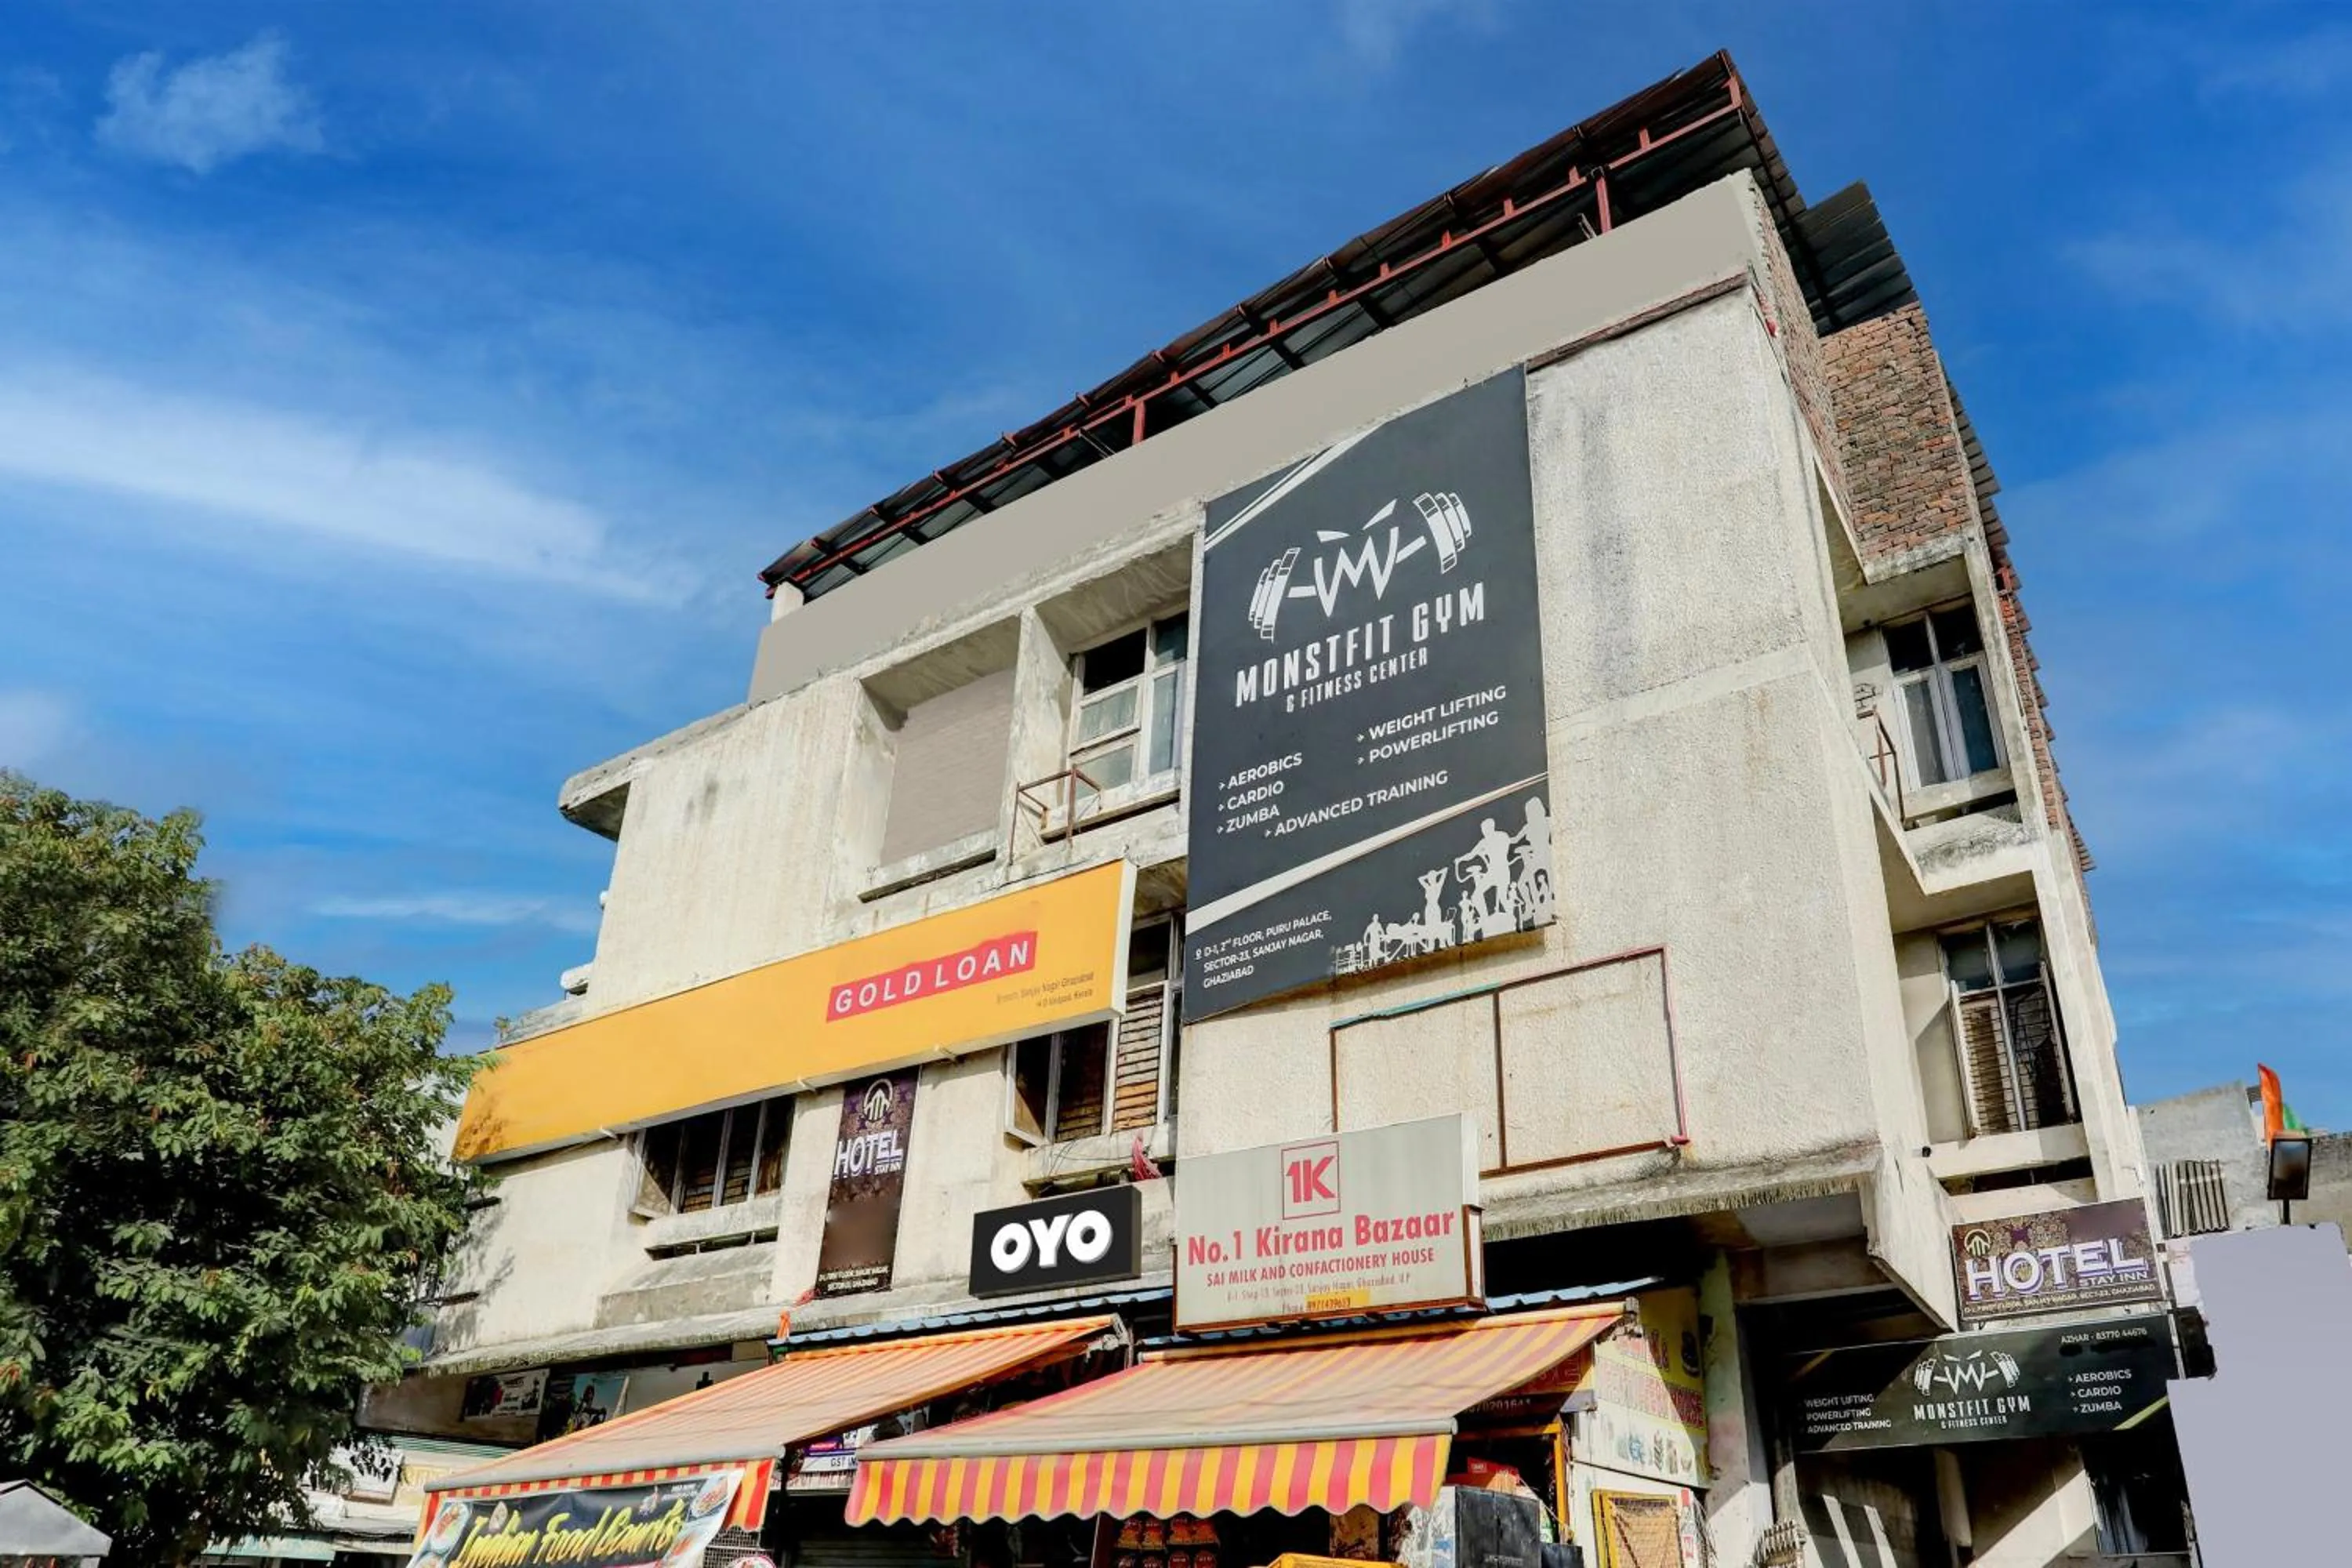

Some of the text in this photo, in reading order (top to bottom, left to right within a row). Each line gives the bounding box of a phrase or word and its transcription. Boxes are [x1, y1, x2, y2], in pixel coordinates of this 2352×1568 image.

[1236, 582, 1484, 707] MONSTFIT GYM
[1301, 670, 1363, 708] FITNESS
[1370, 647, 1428, 684] CENTER
[1370, 685, 1507, 742] WEIGHT LIFTING
[1370, 711, 1499, 764] POWERLIFTING
[1228, 752, 1303, 789] AEROBICS
[1228, 781, 1284, 811] CARDIO
[1274, 770, 1449, 837] ADVANCED TRAINING
[1226, 804, 1280, 833] ZUMBA
[1266, 922, 1292, 938] PURU
[1294, 910, 1332, 930] PALACE,
[1252, 941, 1288, 959] SANJAY
[835, 971, 922, 1013] GOLD
[935, 940, 1029, 988] LOAN
[1203, 965, 1254, 989] GHAZIABAD
[833, 1129, 904, 1179] HOTEL
[1286, 1155, 1338, 1203] 1K
[991, 1210, 1113, 1274] OYO
[1188, 1211, 1454, 1265] No.1 Kirana Bazaar
[1207, 1248, 1434, 1287] SAI MILK AND CONFACTIONERY HOUSE
[1965, 1236, 2149, 1301] HOTEL
[2078, 1270, 2148, 1287] STAY INN
[2075, 1369, 2132, 1383] AEROBICS
[2078, 1385, 2122, 1398] CARDIO
[1804, 1394, 1875, 1408] WEIGHT LIFTING
[1806, 1407, 1871, 1421] POWERLIFTING
[1913, 1396, 2031, 1421] MONSTFIT GYM
[2079, 1401, 2122, 1413] ZUMBA
[1807, 1419, 1892, 1434] ADVANCED TRAINING
[1948, 1418, 1978, 1429] FITNESS
[1980, 1415, 2008, 1426] CENTER
[448, 1509, 540, 1568] Indian
[532, 1505, 613, 1566] Food
